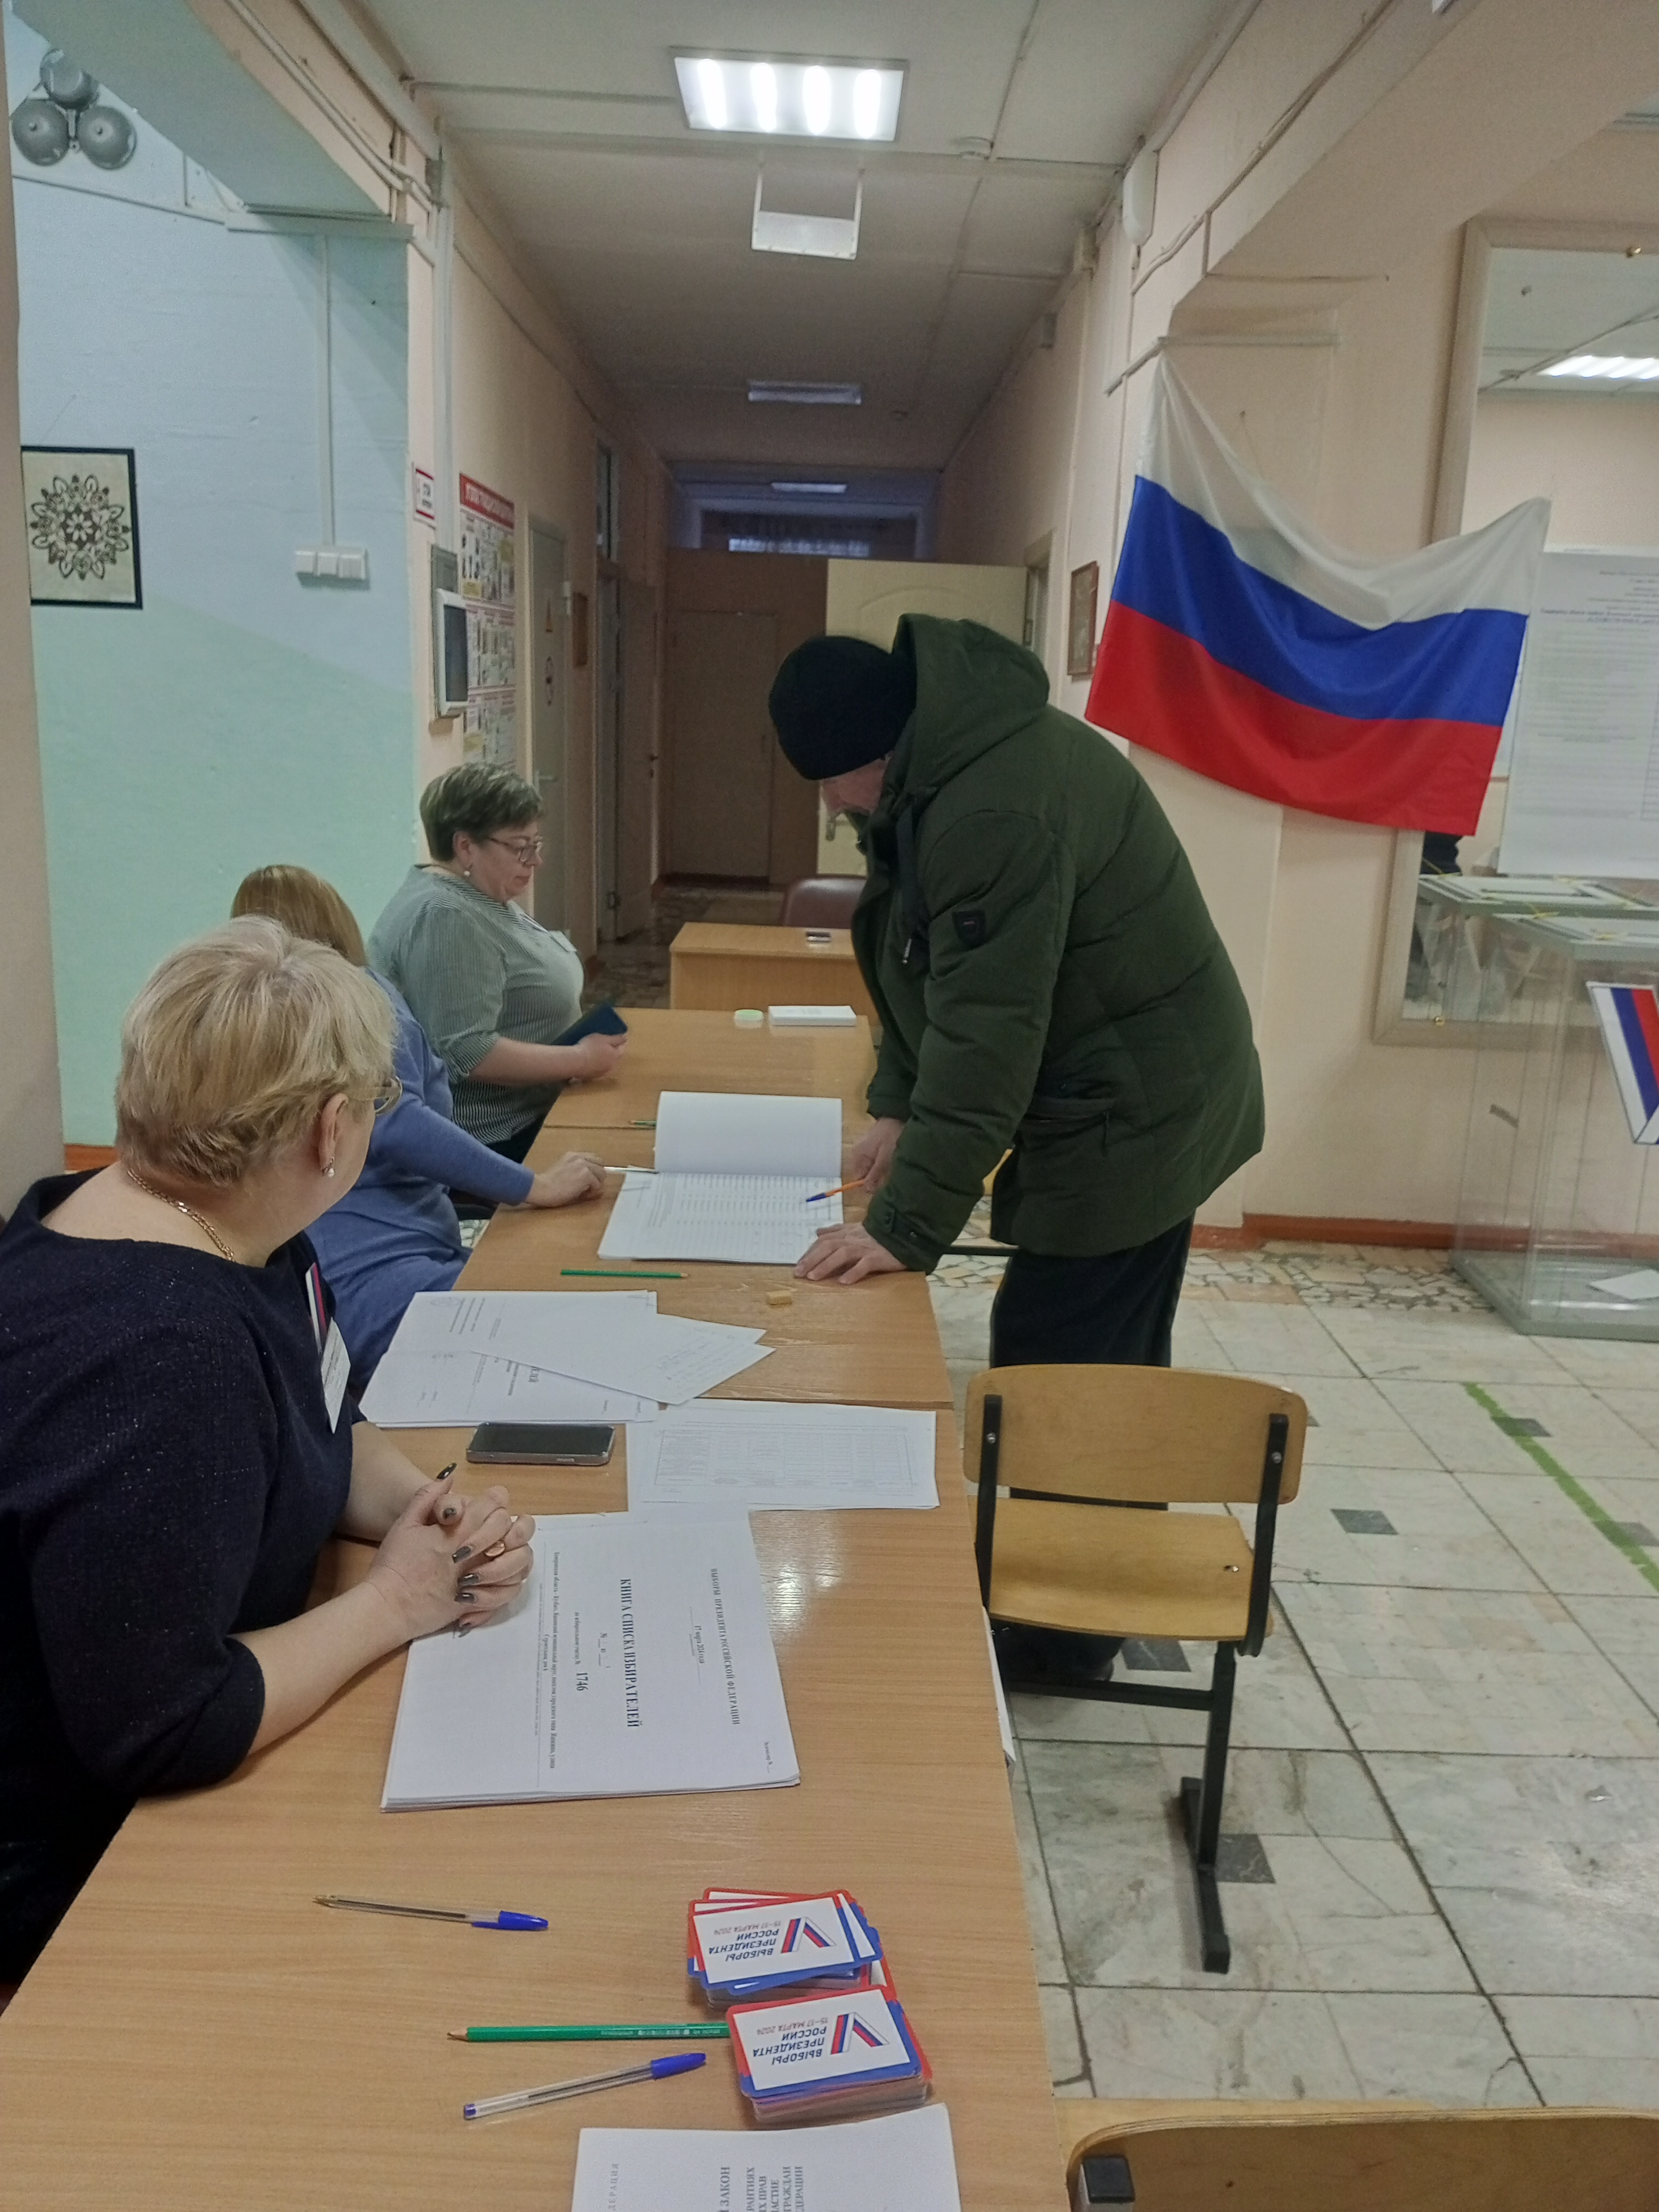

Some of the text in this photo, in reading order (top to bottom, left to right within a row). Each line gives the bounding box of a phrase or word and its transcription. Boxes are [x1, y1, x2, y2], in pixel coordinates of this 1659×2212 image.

[620, 1578, 642, 1727] КНИГА СПИСКА ИЗБИРАТЕЛЕЙ
[710, 1568, 740, 1725] ВЫБОРЫ ПРЕЗИДЕНТА РОССИЙСКОЙ ФЕДЕРАЦИИ
[576, 1672, 588, 1691] 1746
[736, 1928, 779, 1941] РОССИИ
[709, 1938, 776, 1954] ПРЕЗИДЕНТА
[725, 1948, 773, 1962] ВЫБОРЫ
[778, 2021, 804, 2031] МАРТА
[782, 2026, 827, 2041] РОССИИ
[753, 2038, 825, 2057] ПРЕЗИДЕНТА
[771, 2049, 822, 2065] ВЫБОРЫ
[607, 2164, 619, 2212] ДЕРАЦИЯ
[720, 2167, 730, 2206] ЗАКОН
[783, 2166, 791, 2212] ГРАЖДАН
